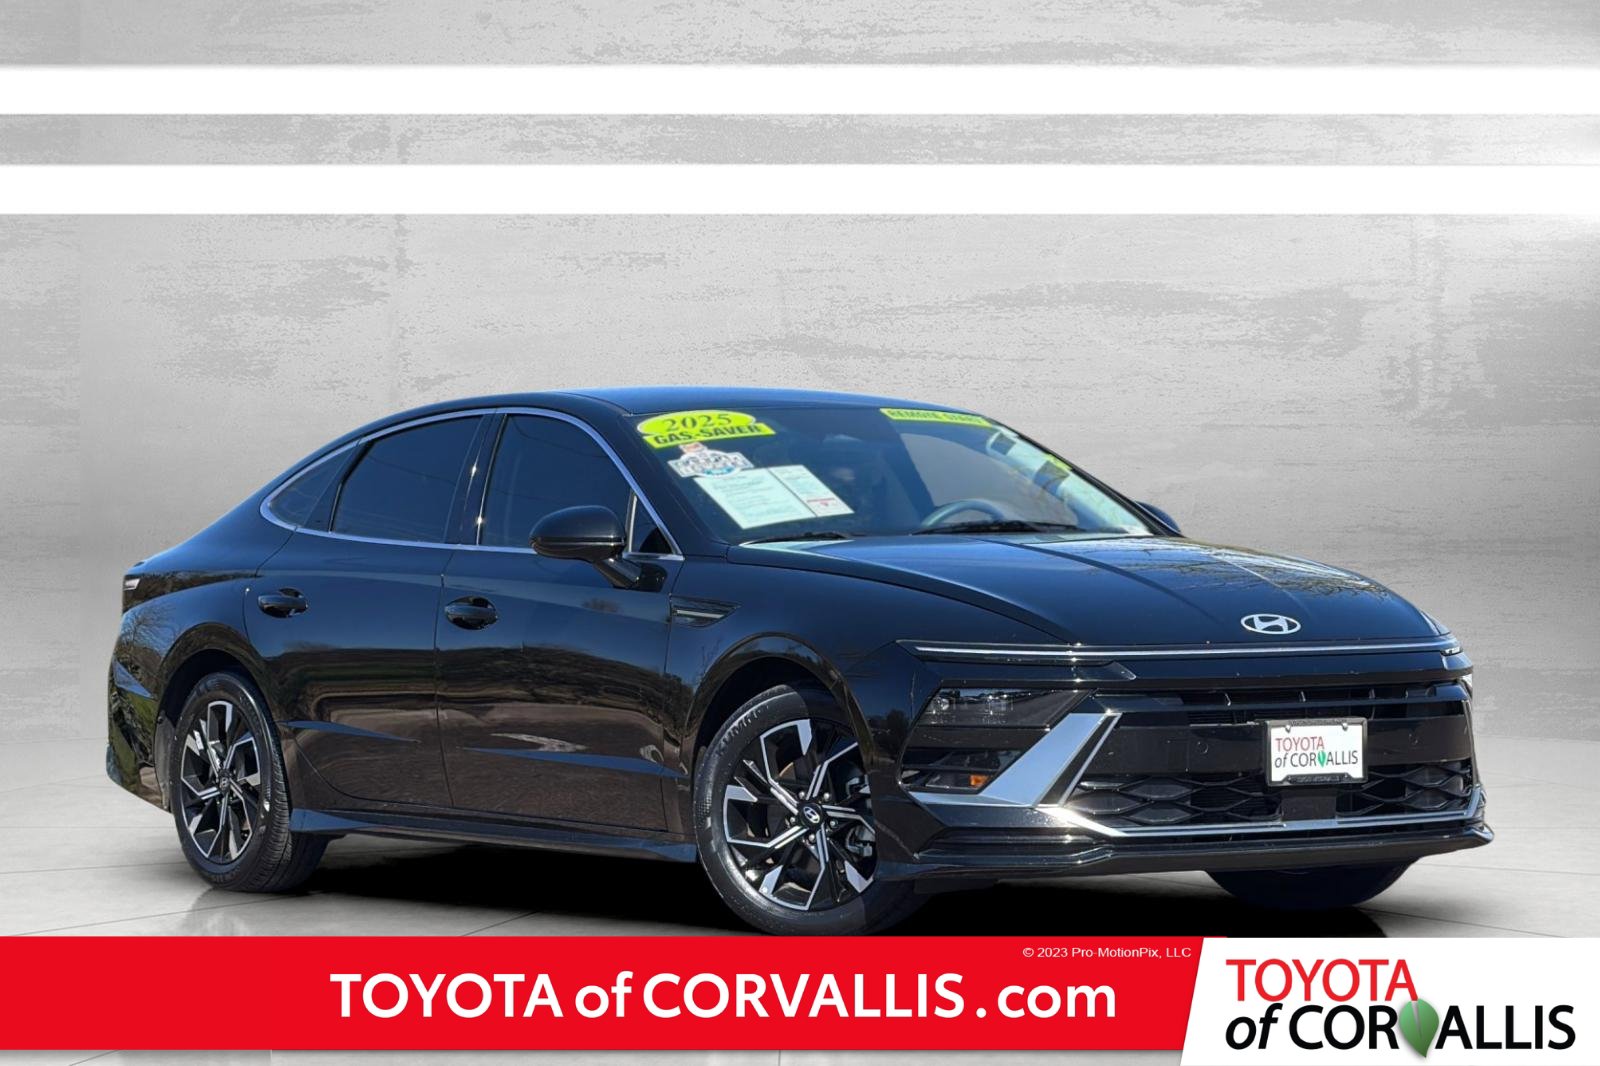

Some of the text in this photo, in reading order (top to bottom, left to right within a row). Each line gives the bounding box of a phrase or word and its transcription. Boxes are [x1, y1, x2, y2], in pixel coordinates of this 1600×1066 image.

[663, 413, 732, 432] 2025
[1275, 736, 1325, 752] TOYOTA
[1274, 750, 1358, 768] of CORVALLIS
